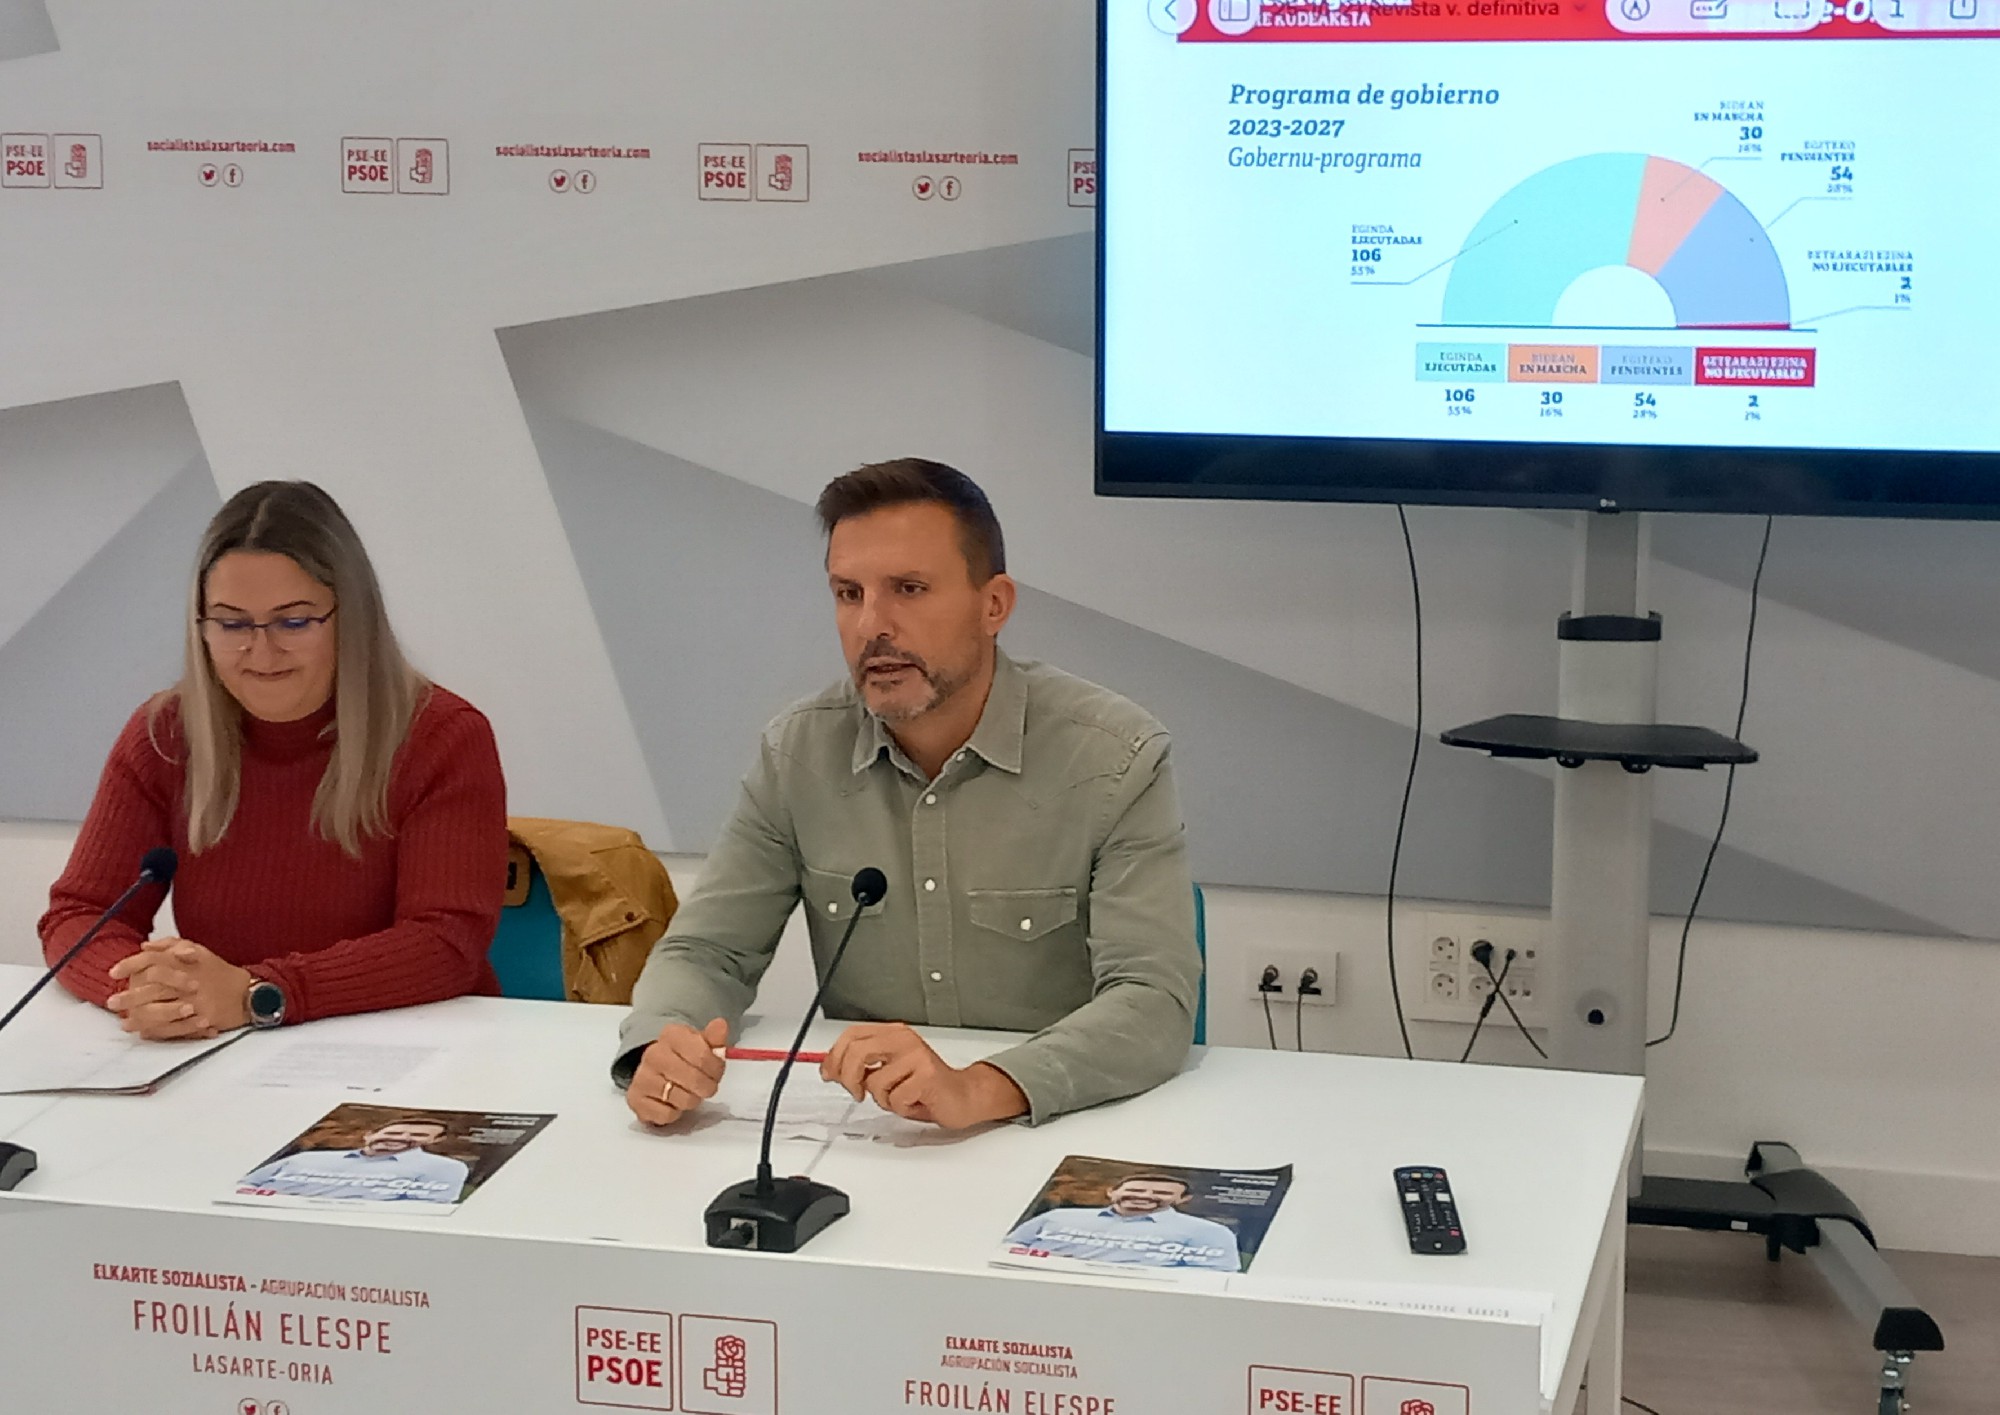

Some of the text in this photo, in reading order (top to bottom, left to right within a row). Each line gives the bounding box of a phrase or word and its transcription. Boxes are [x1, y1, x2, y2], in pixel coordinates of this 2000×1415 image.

[1447, 2, 1462, 16] v.
[1466, 0, 1560, 17] definitiva
[1228, 82, 1500, 110] Programa de gobierno
[1228, 119, 1345, 138] 2023-2027
[1739, 126, 1763, 140] 30
[347, 148, 388, 162] PSE-EE
[703, 155, 746, 169] PSE-EE
[1228, 145, 1423, 174] Gobernu-programa
[6, 159, 46, 176] PSOE
[347, 164, 390, 182] PSOE
[1830, 165, 1853, 181] 54
[703, 171, 747, 189] PSOE
[1351, 248, 1382, 263] 106
[1445, 388, 1476, 402] 106
[1540, 391, 1563, 405] 30
[1633, 392, 1657, 406] 54
[93, 1262, 158, 1285] ELKARTE
[162, 1269, 247, 1293] SOZIALISTA
[260, 1278, 346, 1301] AGRUPACIÓN
[351, 1286, 431, 1308] SOCIALISTA
[133, 1299, 392, 1355] FROILÁN ELESPE
[586, 1327, 662, 1354] PSE-EE
[946, 1336, 1074, 1361] ELKARTE SOZIALISTA
[192, 1353, 334, 1385] LASARTE-ORIA
[586, 1354, 664, 1388] PSOE
[1014, 1361, 1079, 1379] SOCIALISTA
[904, 1381, 1011, 1414] FROILÁN
[1259, 1388, 1342, 1415] PSE-EE
